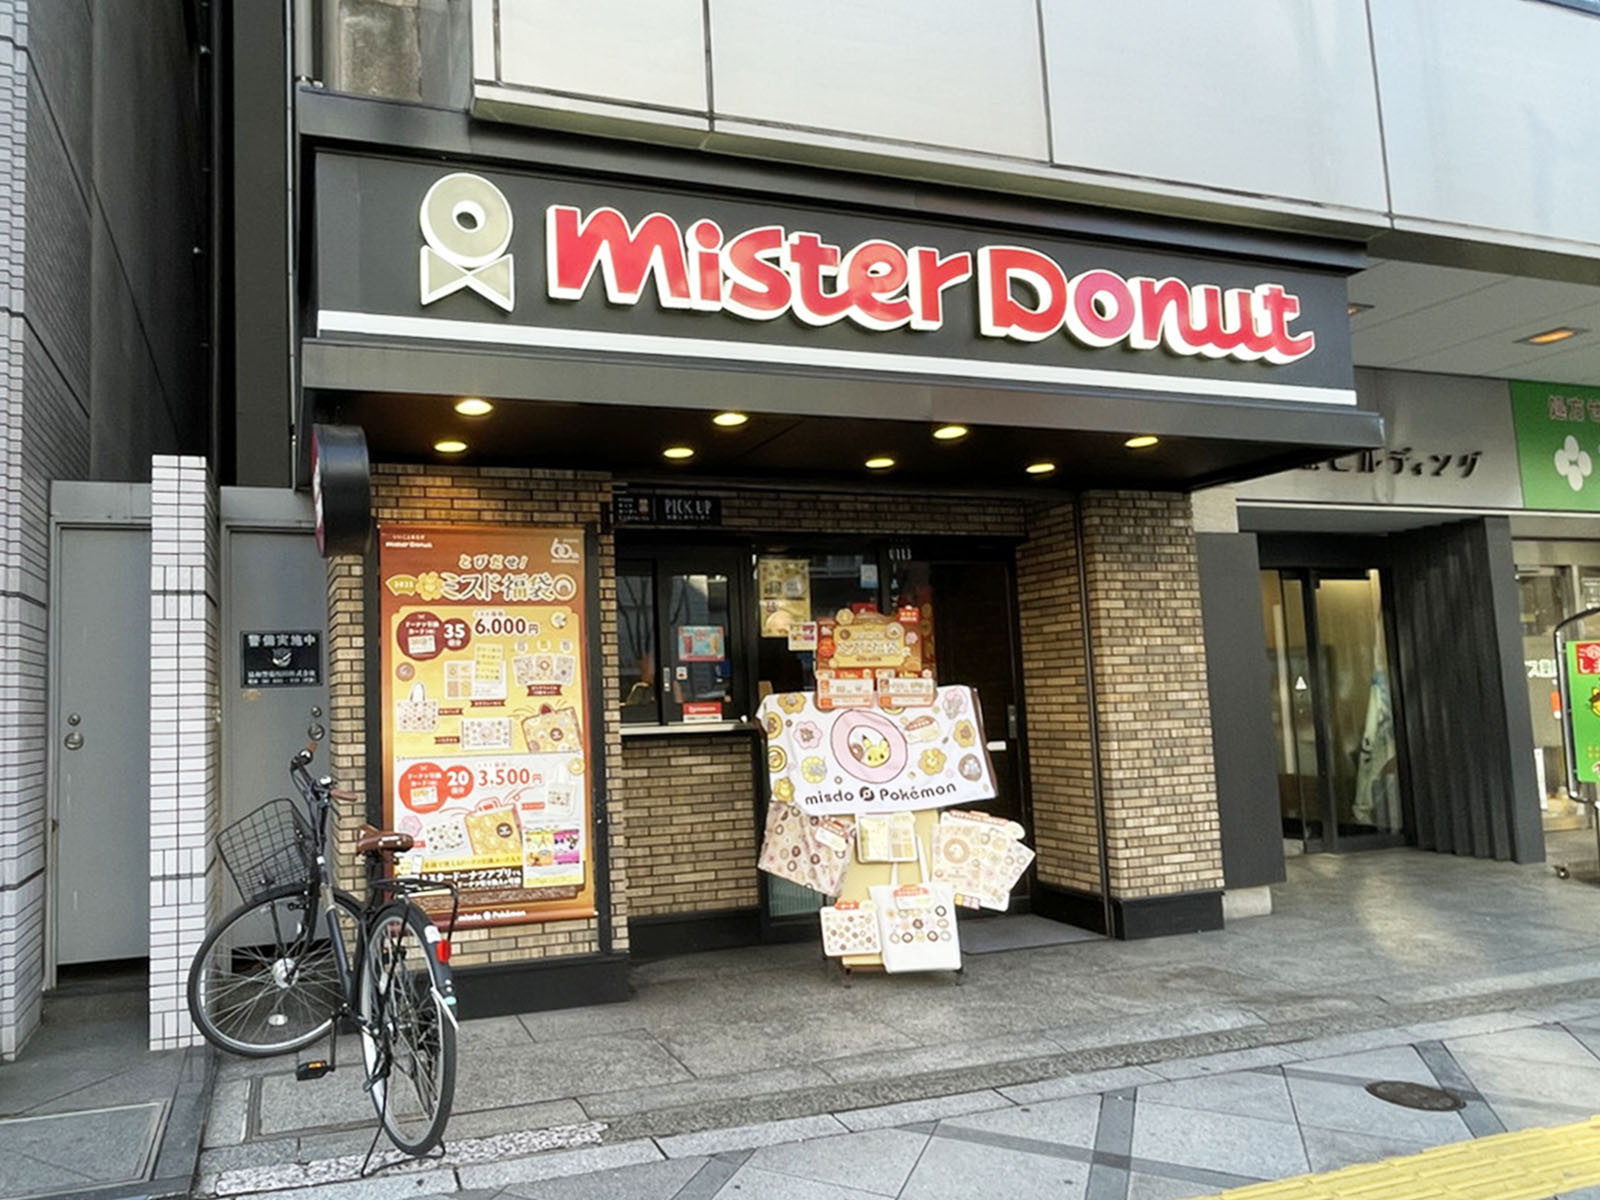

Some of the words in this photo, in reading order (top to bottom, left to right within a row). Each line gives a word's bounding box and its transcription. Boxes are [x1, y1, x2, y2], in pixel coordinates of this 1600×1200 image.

[977, 243, 1317, 367] Donut
[664, 498, 692, 514] PICK
[696, 499, 712, 515] UP
[440, 571, 556, 602] ミスド福袋
[443, 623, 466, 639] 35
[446, 771, 470, 786] 20
[805, 791, 855, 805] misdo
[879, 782, 957, 801] Pokémon
